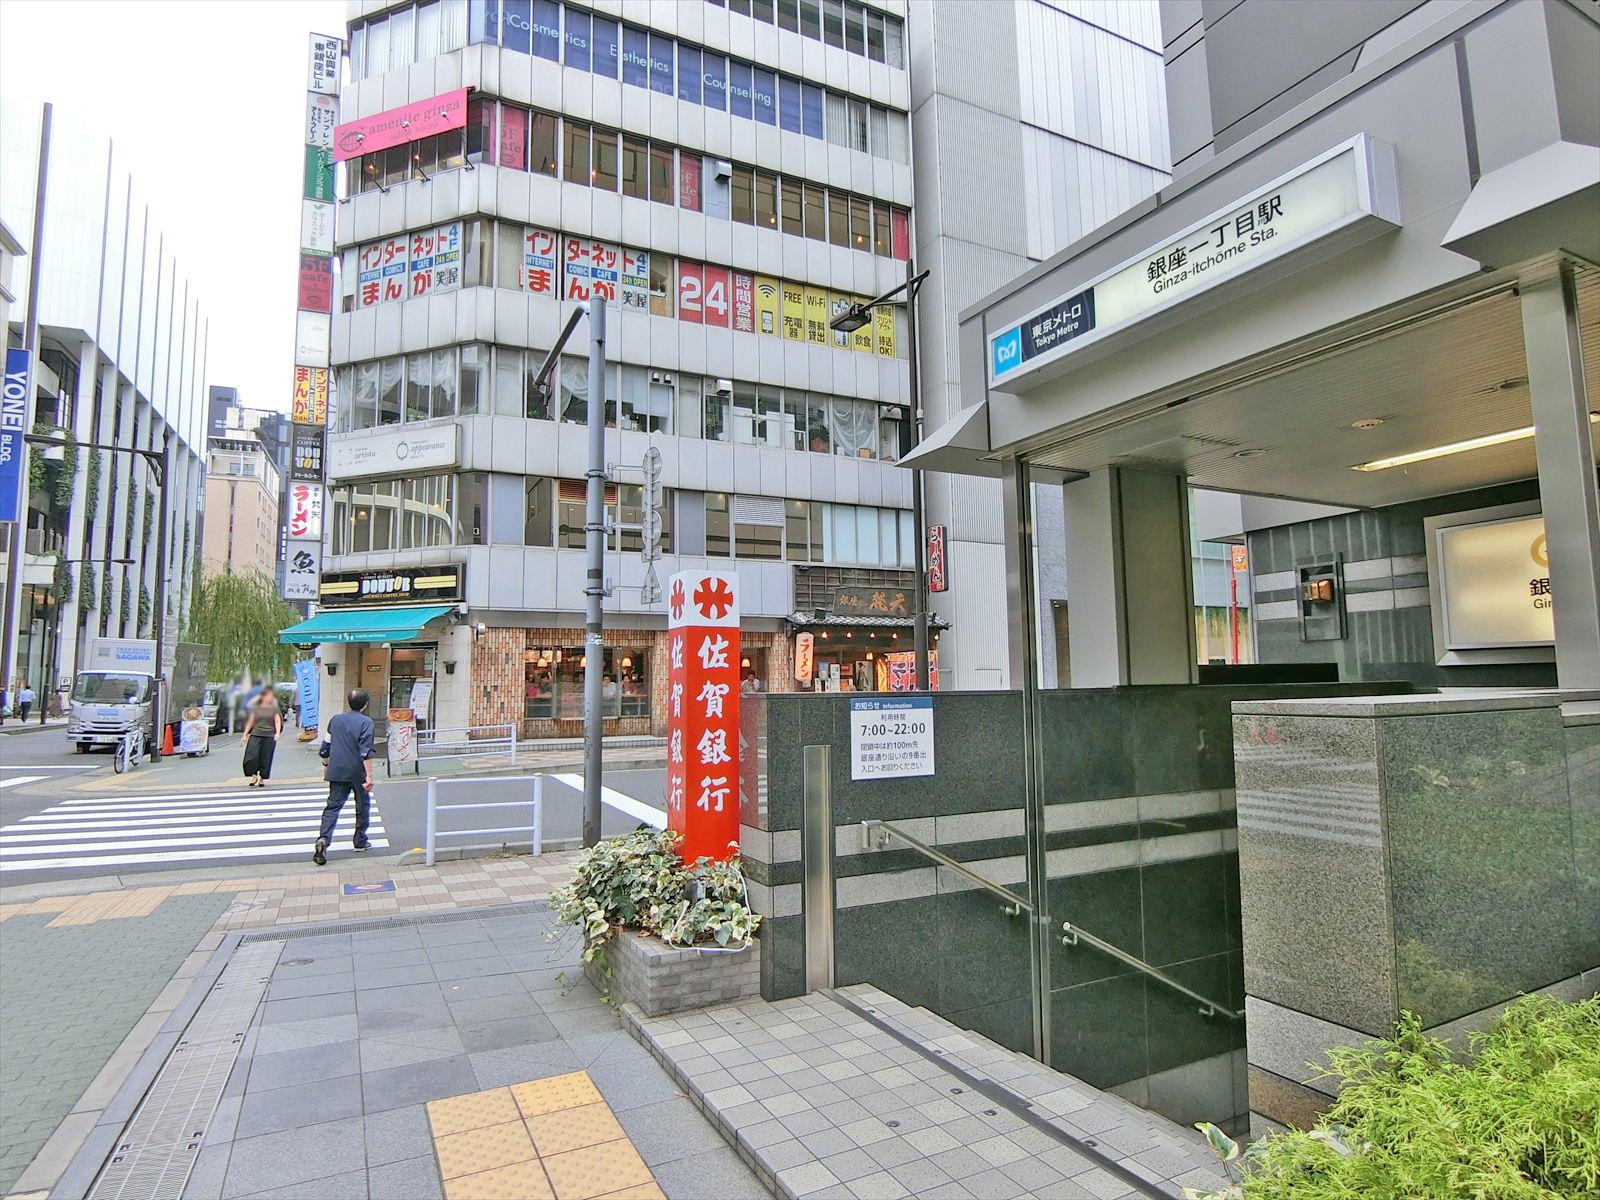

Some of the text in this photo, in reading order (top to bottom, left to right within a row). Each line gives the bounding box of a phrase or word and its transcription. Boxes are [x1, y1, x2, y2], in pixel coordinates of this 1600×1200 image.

[509, 14, 587, 48] Cosmetics
[313, 42, 325, 89] 東銀座ビル
[326, 40, 337, 79] 西山興業
[610, 44, 669, 73] Esthetics
[424, 100, 460, 120] ginza
[414, 121, 439, 134] bistro
[1147, 194, 1283, 283] 銀座一丁目駅
[362, 229, 448, 270] インターネット
[526, 232, 634, 274] インターネット
[386, 264, 403, 276] COMICS
[417, 258, 430, 269] CAFE
[568, 264, 590, 276] COMICS
[1153, 226, 1278, 294] Ginza-itchōme Sta.
[302, 274, 328, 282] cafe
[596, 270, 612, 280] CAFE
[622, 275, 647, 288] 24h OPEN
[302, 285, 328, 294] bistro
[362, 270, 432, 306] まんが
[528, 269, 615, 302] まんが
[622, 290, 647, 309] 笑屋
[680, 276, 728, 316] 24
[736, 274, 752, 332] 時間営業
[784, 291, 826, 309] FREE Wi-Fi
[784, 316, 803, 329] 充電
[808, 320, 825, 332] 無料
[1031, 303, 1082, 341] 東京メトロ
[788, 328, 799, 339] 器
[808, 331, 825, 343] 貸出
[855, 334, 871, 348] 飲食
[878, 335, 892, 348] 持込
[1035, 320, 1079, 348] Tokyo Metro
[879, 346, 893, 356] OK!
[296, 368, 308, 414] まんが
[314, 370, 326, 422] インターネット
[2, 371, 27, 432] YONEI
[354, 450, 376, 459] artista
[410, 442, 446, 455] appearance
[292, 485, 309, 536] ラーメン
[291, 550, 316, 574] 魚
[362, 576, 410, 594] DOUTOR
[800, 638, 810, 678] ラーメン
[303, 677, 318, 722] COFFEE
[854, 702, 880, 710] お知らせ
[670, 634, 684, 812] 佐賀銀行
[696, 634, 732, 812] 佐賀銀行
[861, 751, 926, 762] 銀座通り沿いの9番出
[861, 762, 922, 773] 入口へお回りください
